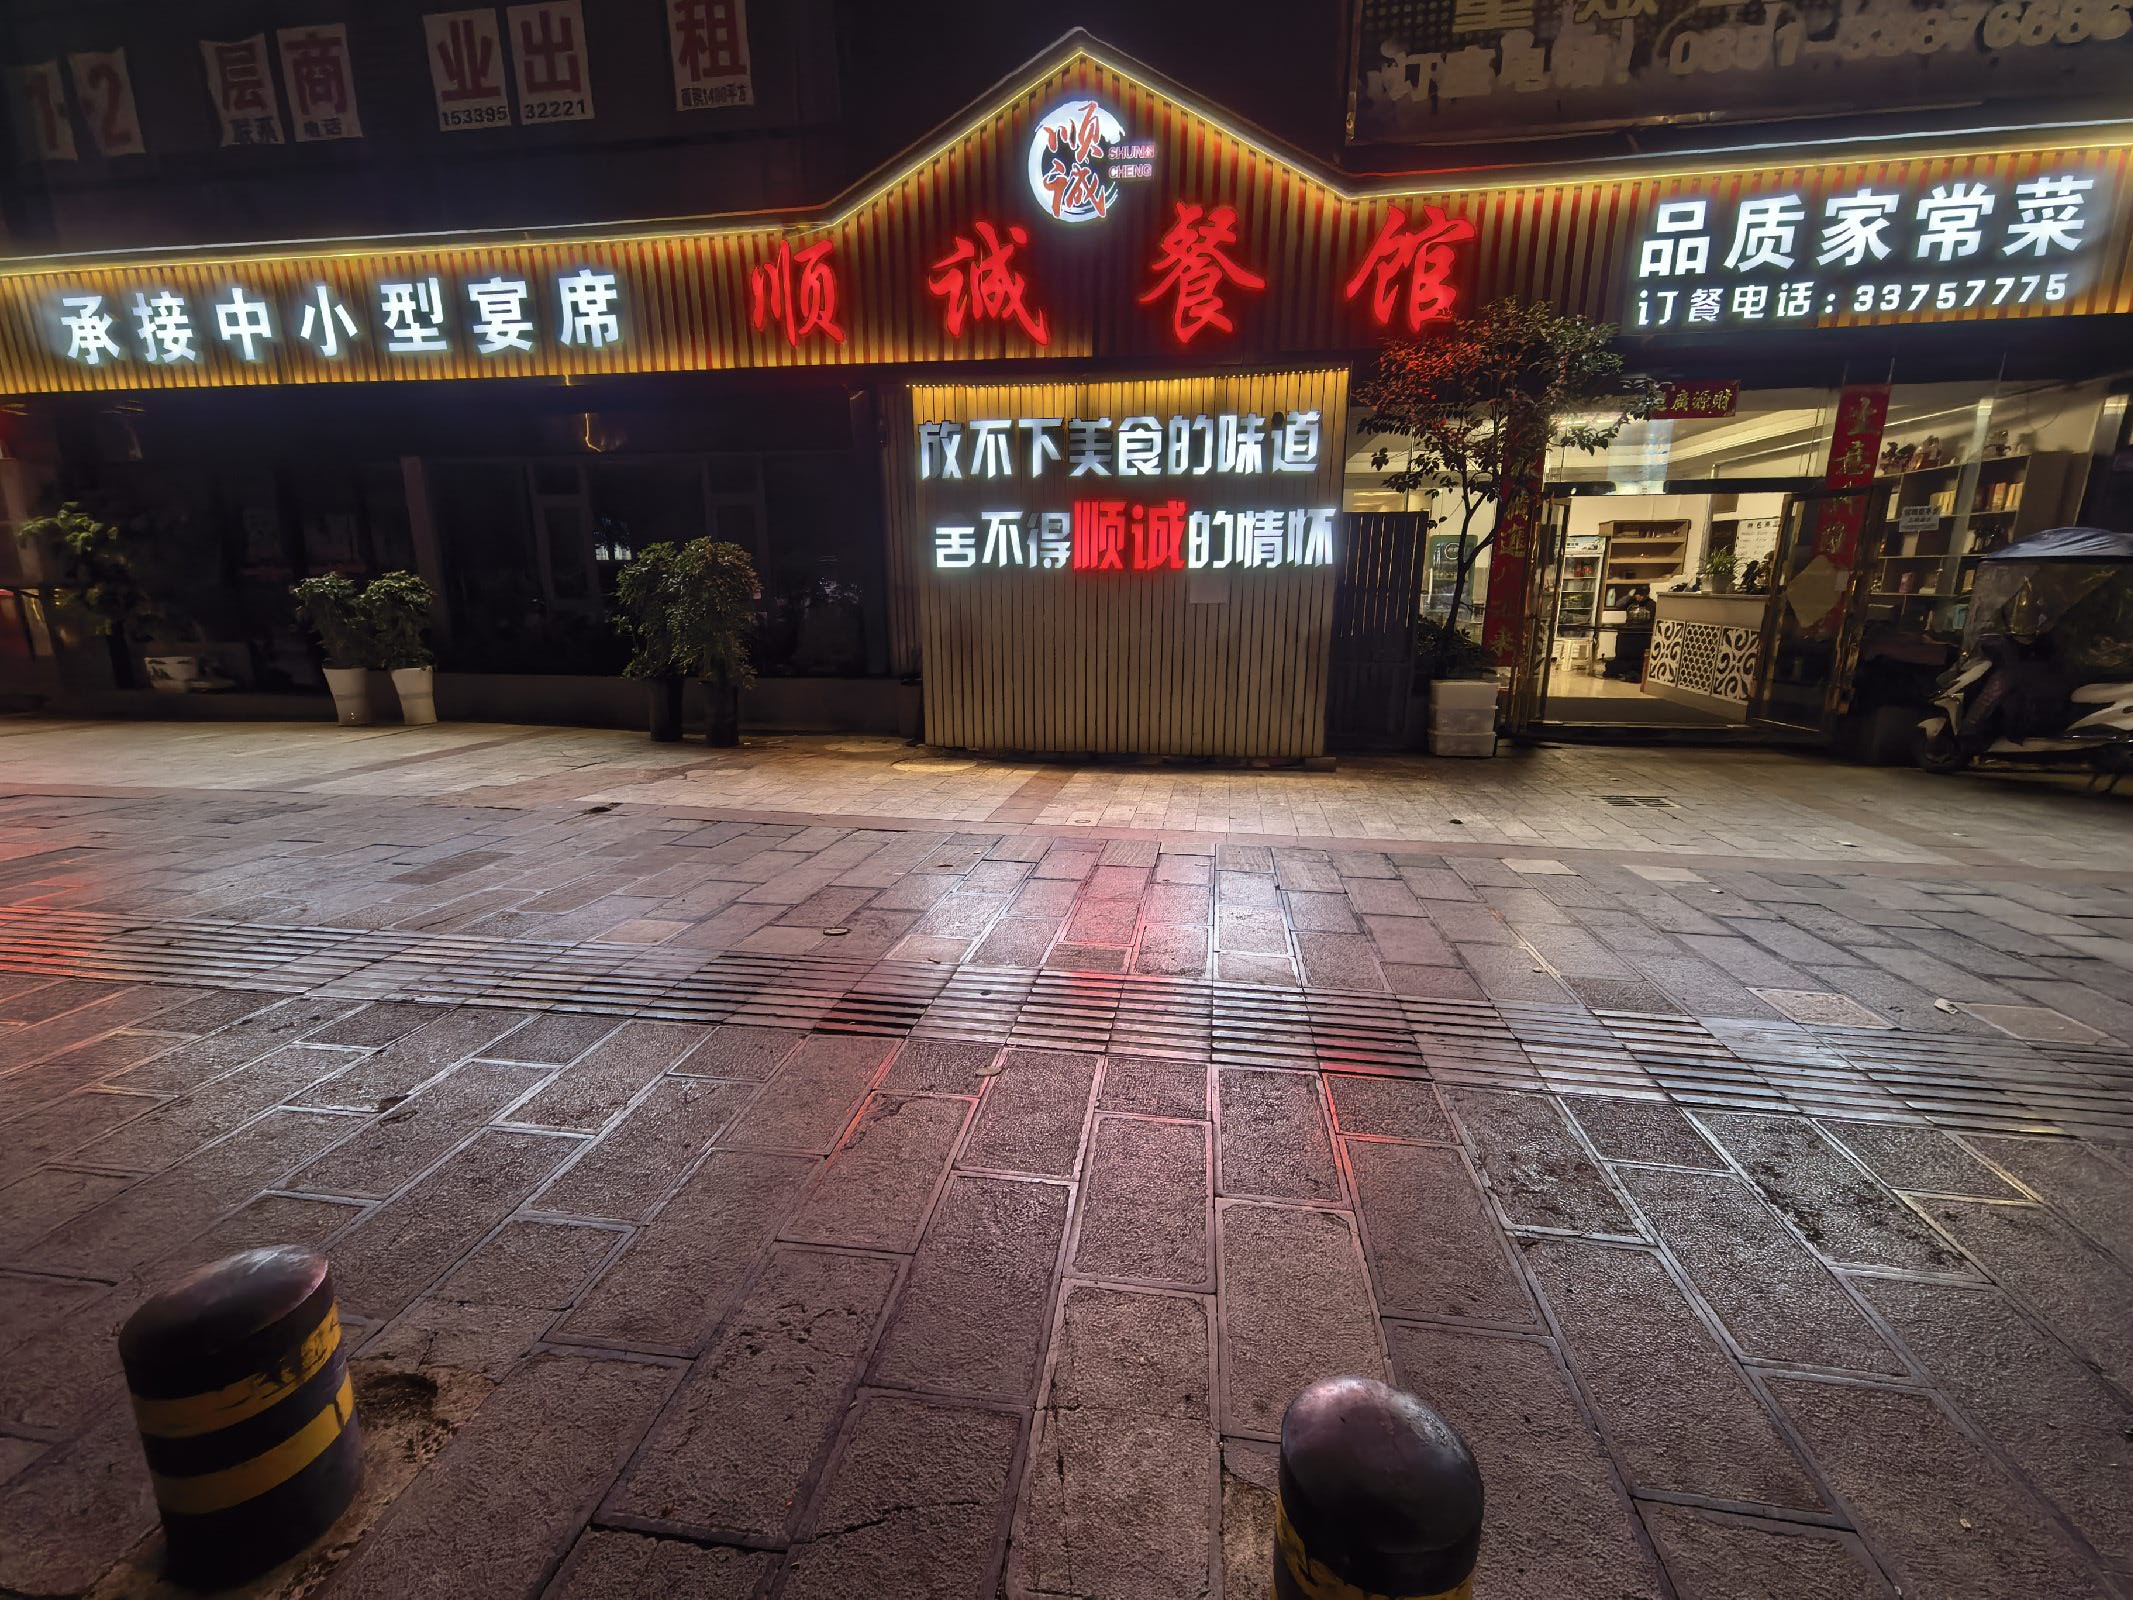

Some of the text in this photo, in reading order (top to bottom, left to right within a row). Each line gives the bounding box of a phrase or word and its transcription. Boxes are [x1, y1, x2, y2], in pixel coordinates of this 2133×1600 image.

[1108, 164, 1152, 178] CHENG
[751, 201, 1476, 347] 顺诚餐馆
[1639, 175, 2094, 278] 品质家常菜
[61, 269, 619, 365] 承接中小型宴席
[917, 411, 1322, 480] 放不下美食的味道
